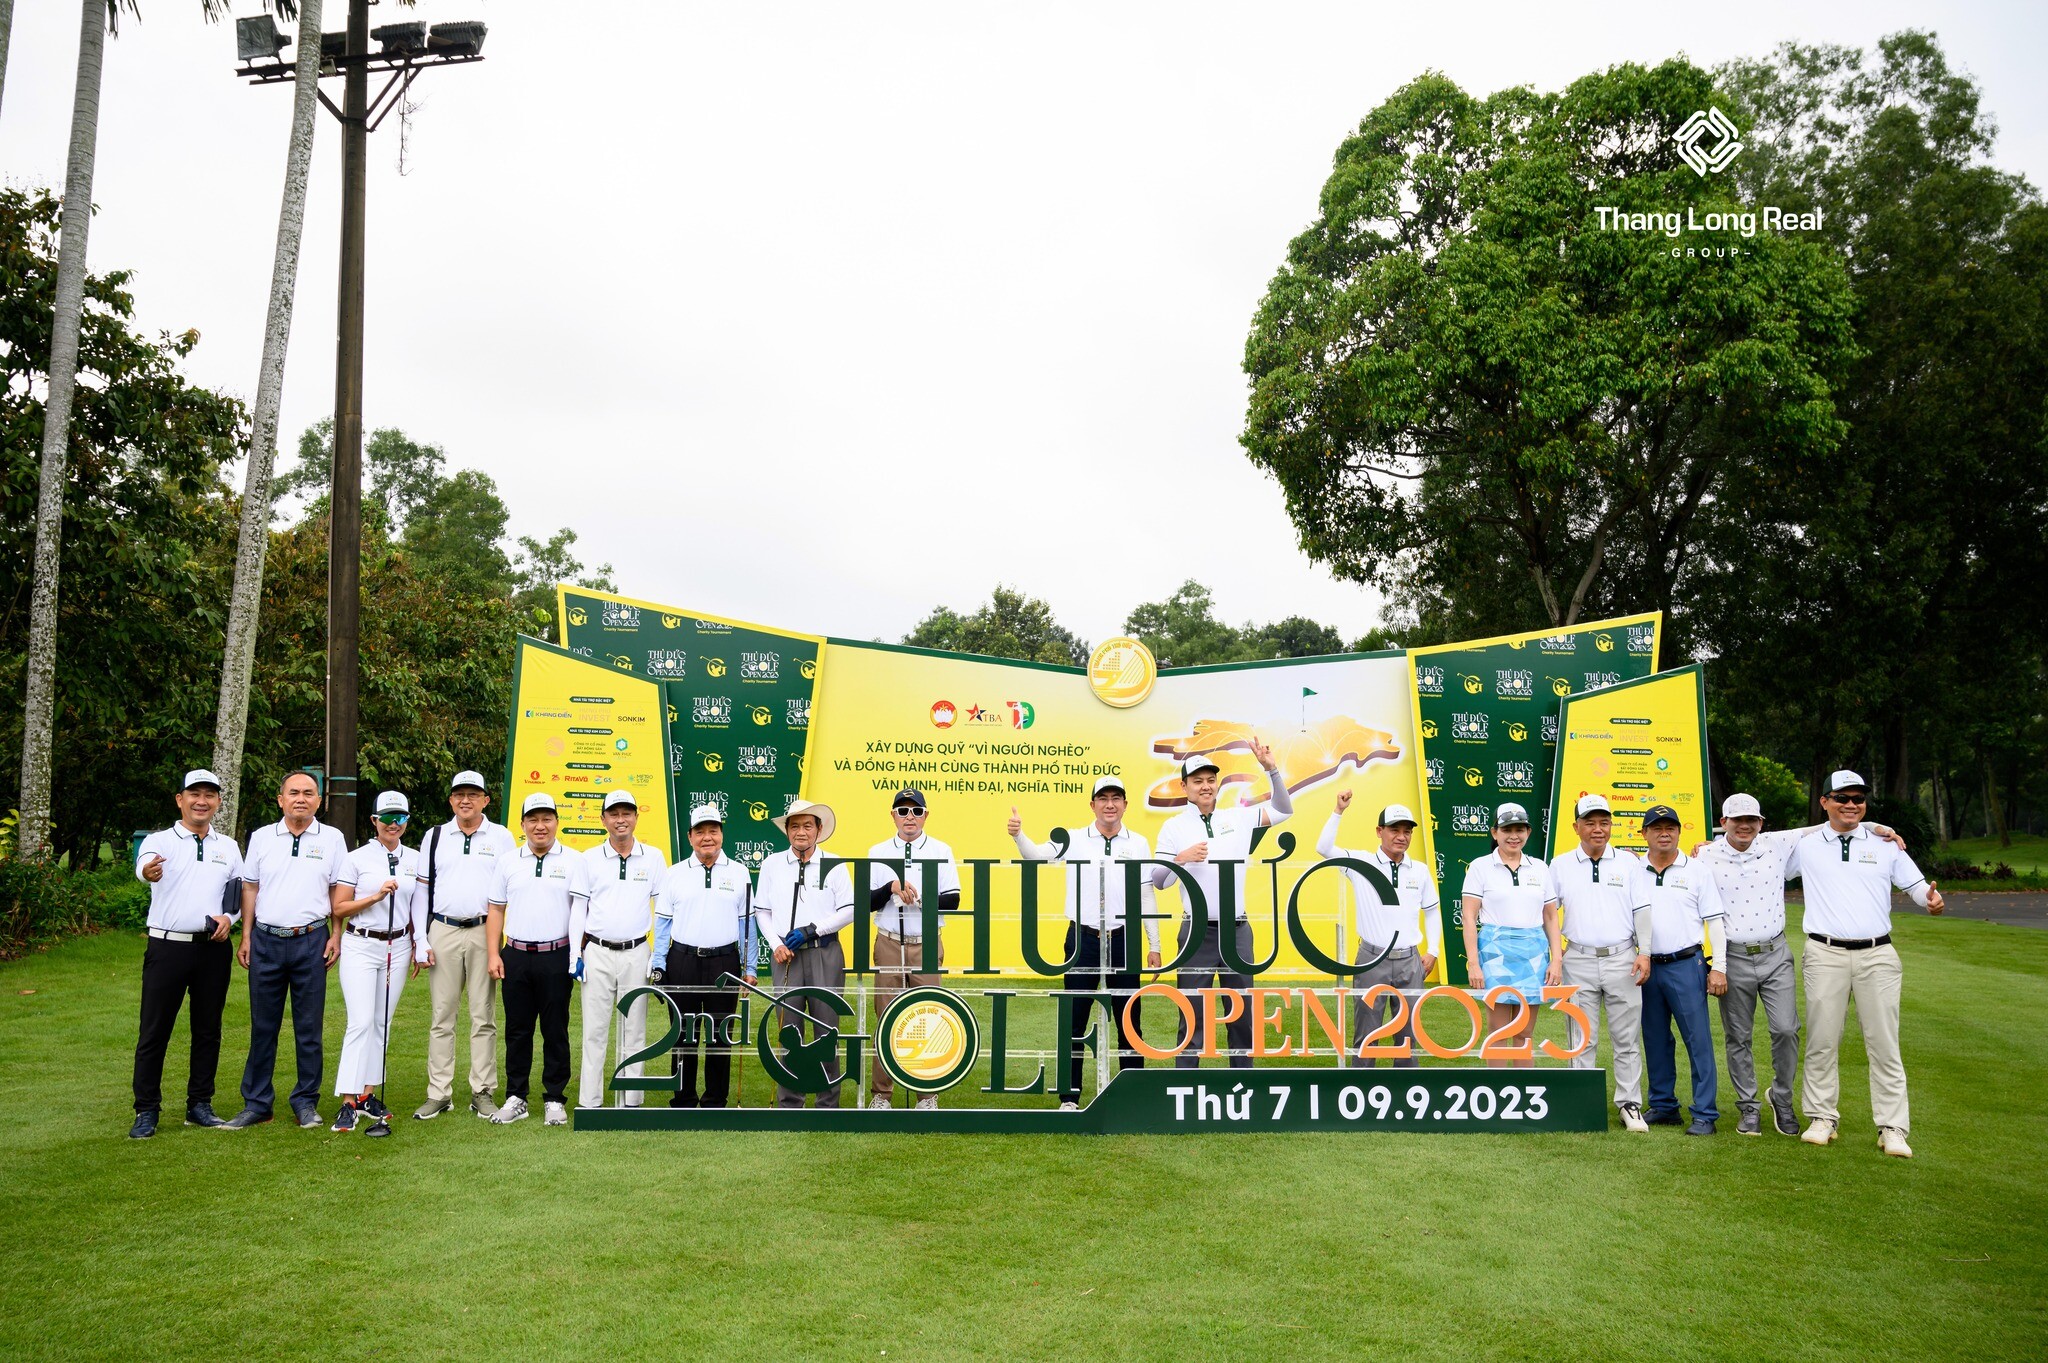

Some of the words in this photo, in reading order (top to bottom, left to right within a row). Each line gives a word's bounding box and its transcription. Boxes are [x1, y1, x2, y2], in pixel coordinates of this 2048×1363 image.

[602, 617, 622, 626] OPEN
[648, 649, 666, 659] THỦ
[667, 649, 686, 660] ĐỨC
[741, 651, 759, 661] THỦ
[760, 651, 780, 662] ĐỨC
[648, 667, 668, 676] OPEN
[741, 669, 761, 678] OPEN
[1496, 669, 1512, 679] THỦ
[1514, 669, 1533, 679] ĐỨC
[1496, 686, 1516, 695] OPEN
[693, 696, 711, 706] THỦ
[712, 696, 731, 706] ĐỨC
[617, 715, 646, 723] SONKIM
[693, 714, 713, 723] OPEN
[1452, 712, 1469, 722] THỦ
[1470, 712, 1489, 723] ĐỨC
[1452, 729, 1472, 738] OPEN
[738, 745, 756, 755] THỦ
[758, 745, 777, 756] ĐỨC
[866, 741, 892, 754] XÂY
[895, 741, 934, 756] DỰNG
[937, 741, 965, 756] QUỸ
[991, 742, 1034, 756] NGƯỜI
[738, 763, 758, 772] OPEN
[833, 757, 852, 771] VÀ
[855, 756, 896, 772] ĐỒNG
[898, 758, 937, 773] HÀNH
[940, 759, 980, 773] CÙNG
[983, 760, 1029, 774] THÀNH
[1032, 757, 1060, 775] PHỐ
[1063, 759, 1089, 775] THỦ
[1092, 759, 1121, 776] ĐỨC
[1497, 761, 1514, 771] THỦ
[1515, 761, 1534, 772] ĐỨC
[872, 777, 900, 790] VĂN
[903, 780, 941, 792] MINH,
[944, 778, 975, 794] HIỆN
[978, 780, 1004, 795] ĐẠI,
[1007, 779, 1050, 793] NGHĨA
[1053, 779, 1084, 793] TÌNH
[1497, 778, 1517, 787] OPEN
[690, 791, 708, 801] THỦ
[709, 791, 728, 801] ĐỨC
[1453, 805, 1469, 815] THỦ
[1470, 805, 1489, 815] ĐỨC
[1453, 822, 1473, 831] OPEN
[735, 840, 753, 850] THỦ
[754, 840, 774, 851] ĐỨC
[819, 826, 1091, 976] THỦ
[1114, 825, 1400, 976] ĐỨC
[609, 986, 751, 1092] 2nd
[1166, 1082, 1254, 1121] Thứ
[1269, 1086, 1291, 1121] 7
[1338, 1086, 1549, 1121] 09.9.2023
